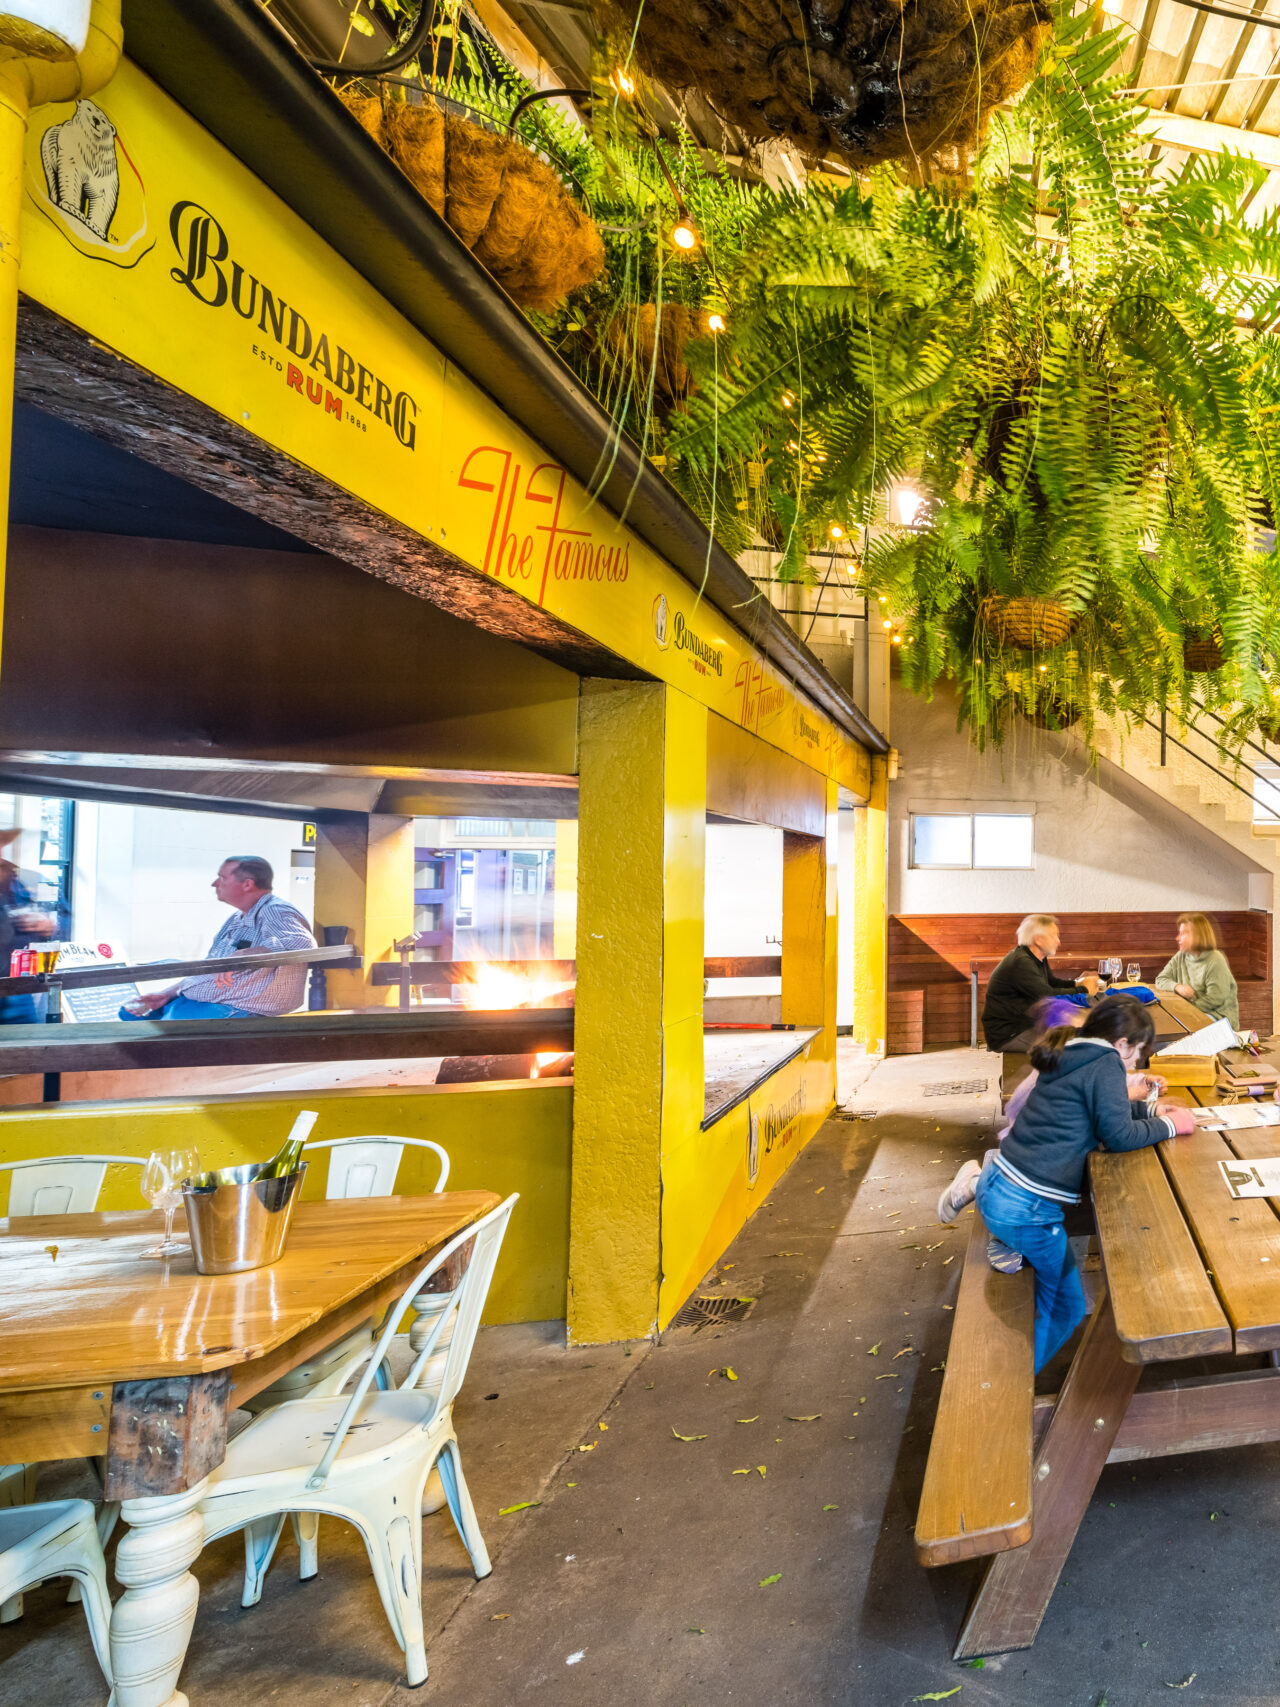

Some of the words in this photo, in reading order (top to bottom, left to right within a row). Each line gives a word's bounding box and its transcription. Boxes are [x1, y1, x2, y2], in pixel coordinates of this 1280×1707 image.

[169, 200, 418, 452] BUNDABERG
[252, 344, 283, 372] ESTD
[286, 361, 343, 422] RUM
[345, 411, 367, 432] 1888
[458, 446, 533, 580] The
[525, 463, 630, 607] Famous
[674, 611, 723, 677] BUNDABERG
